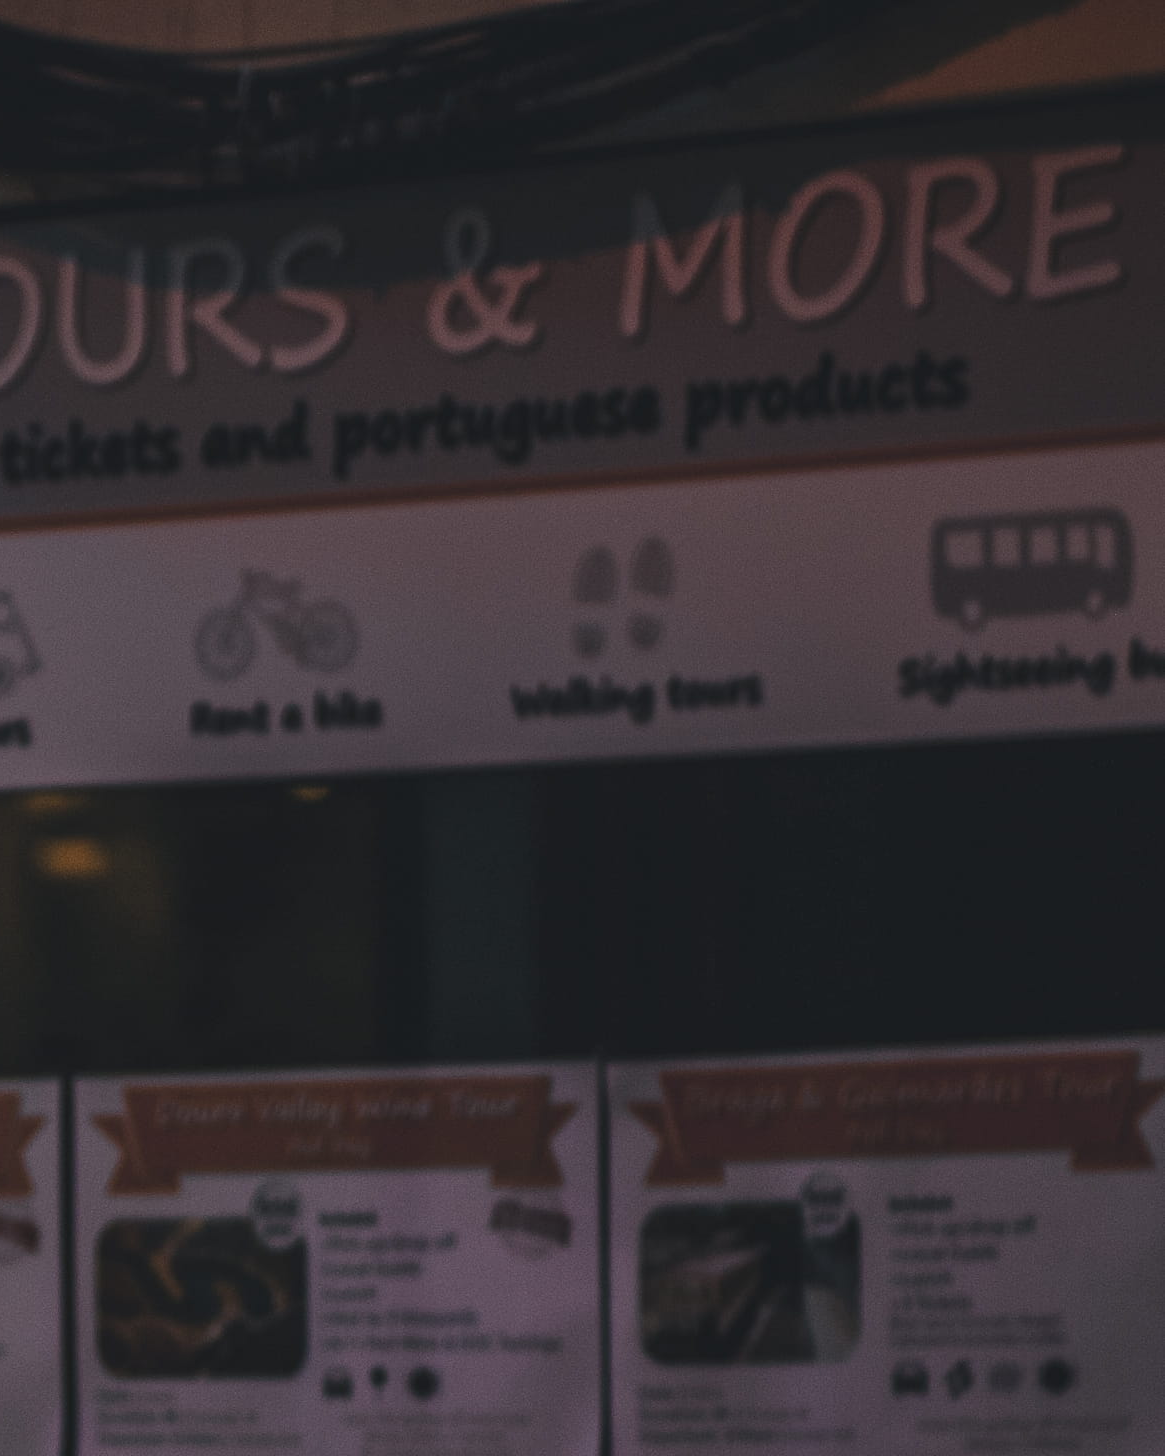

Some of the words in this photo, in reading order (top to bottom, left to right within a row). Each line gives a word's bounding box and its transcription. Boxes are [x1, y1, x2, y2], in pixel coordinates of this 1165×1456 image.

[427, 207, 541, 354] &
[619, 144, 1125, 337] MORE
[0, 413, 181, 484] tickets
[201, 401, 311, 465] and
[334, 383, 662, 480] portuguese
[686, 349, 969, 453] products
[510, 675, 655, 726] Walking
[666, 673, 763, 711] tours
[898, 642, 1115, 708] Sightseeing
[190, 699, 269, 738] Rent
[281, 703, 303, 732] a
[313, 689, 382, 731] bike
